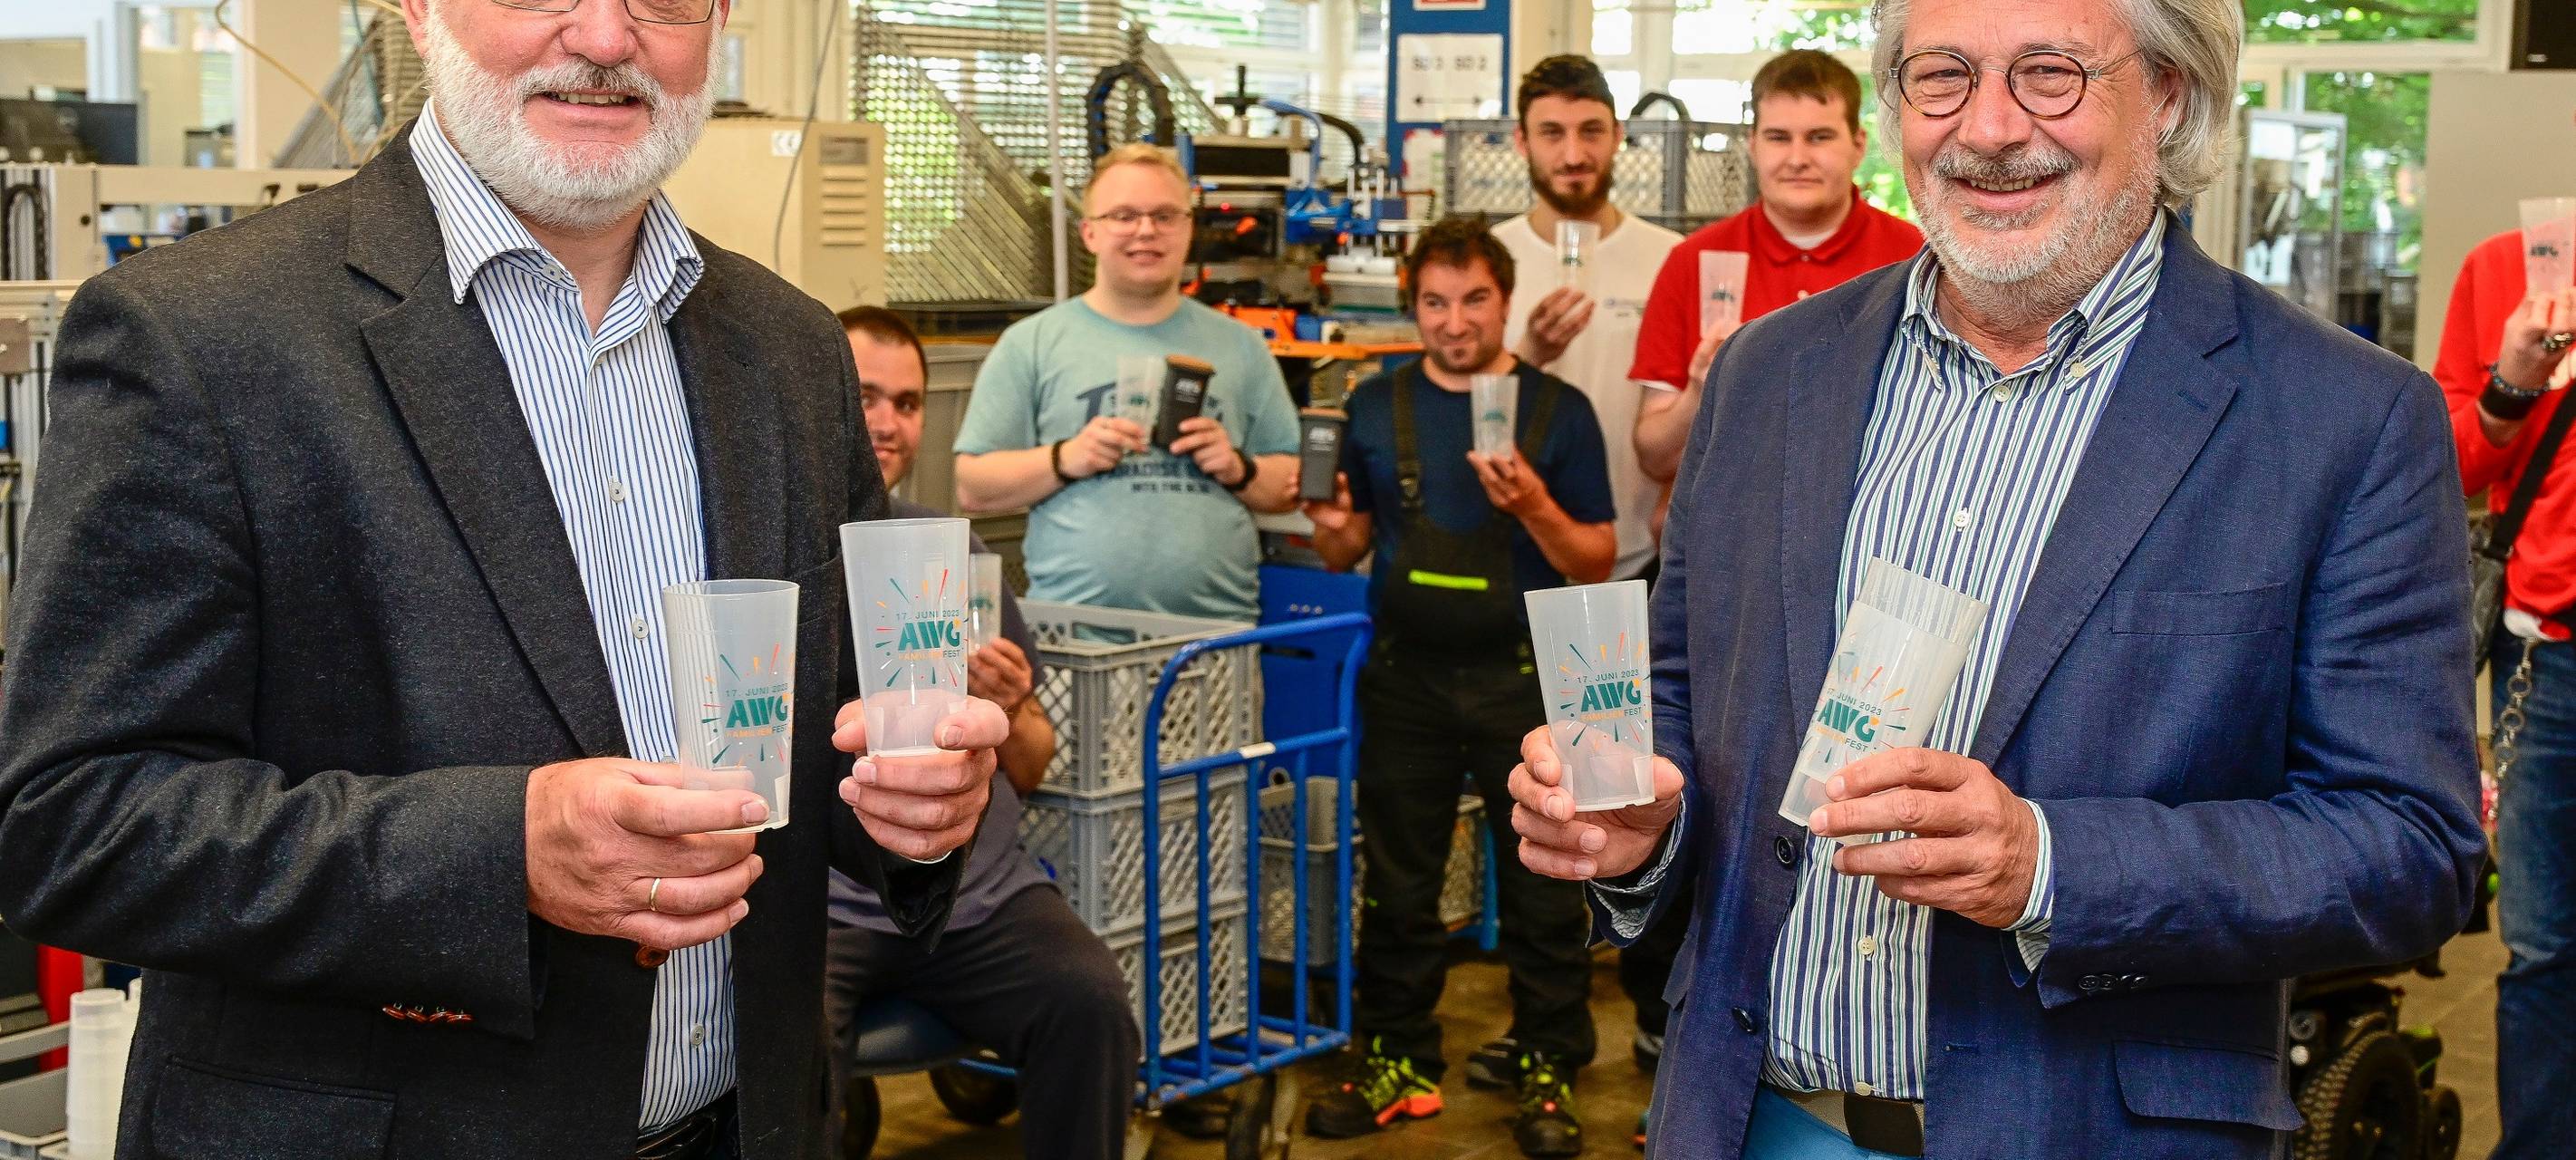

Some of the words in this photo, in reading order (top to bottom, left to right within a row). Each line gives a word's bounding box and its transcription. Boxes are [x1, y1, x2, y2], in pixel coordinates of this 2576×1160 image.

[915, 610, 939, 619] JUNI
[942, 609, 960, 617] 2023
[898, 620, 960, 651] AWG
[1595, 672, 1617, 682] JUNI
[1621, 669, 1639, 678] 2023
[745, 686, 769, 696] JUNI
[1580, 680, 1642, 711] AWG
[1837, 691, 1857, 705] JUNI
[1858, 701, 1882, 716] 2023
[725, 695, 788, 728] AWG
[1817, 698, 1876, 742] AWG
